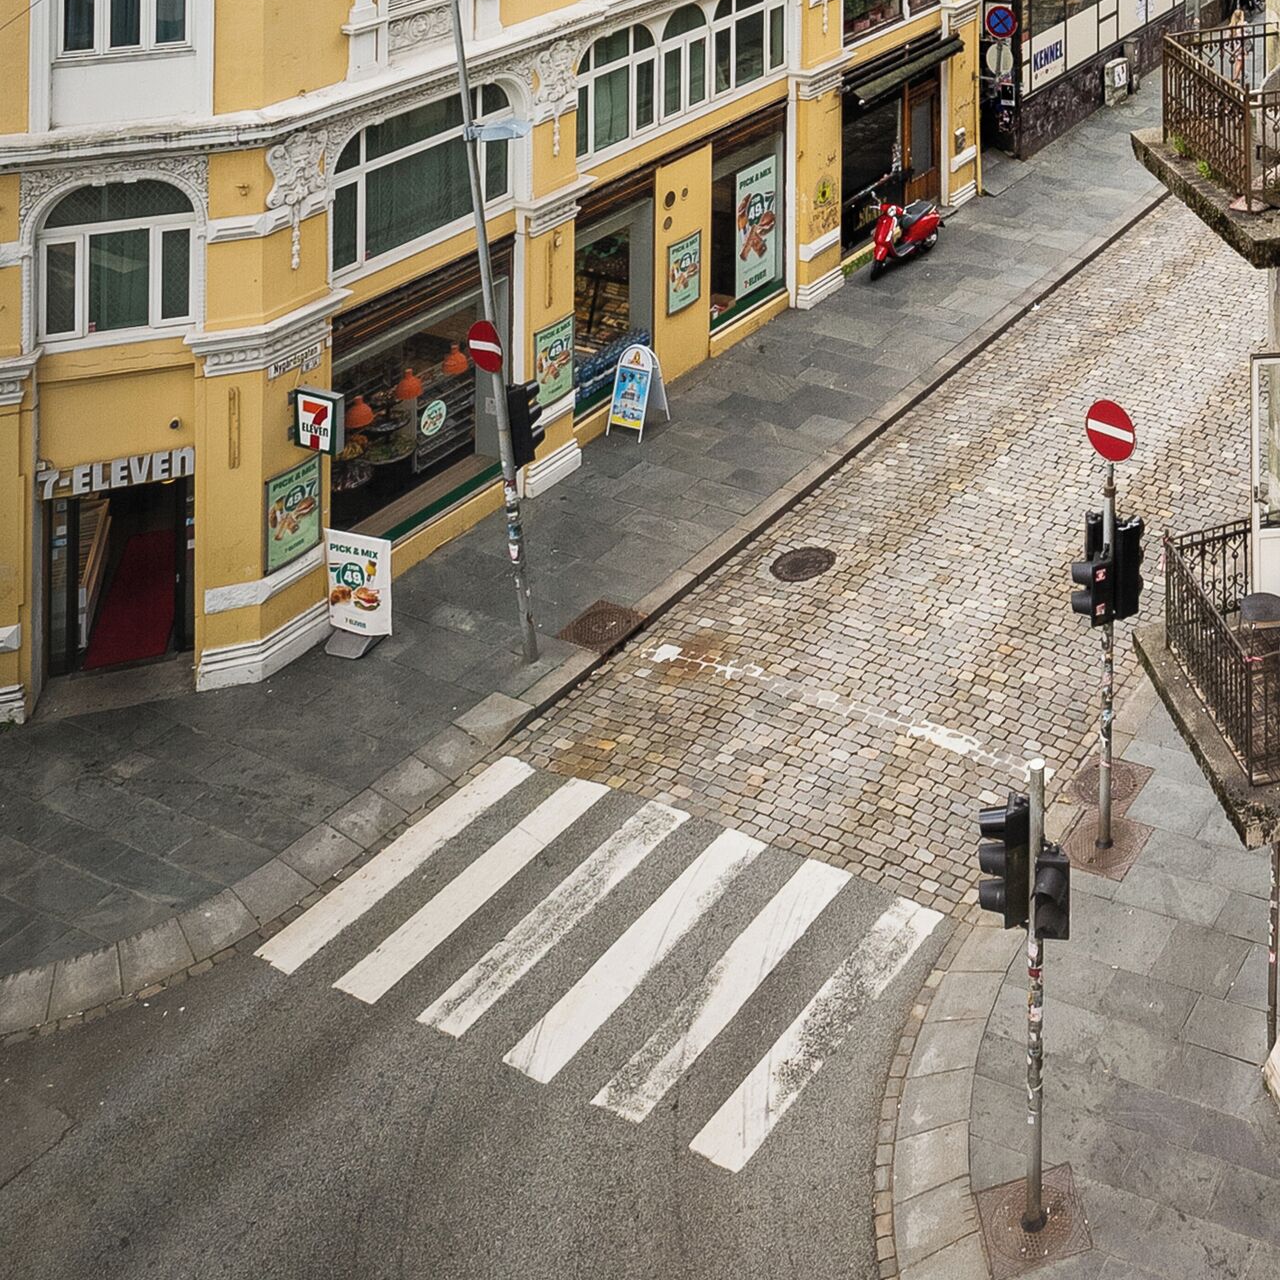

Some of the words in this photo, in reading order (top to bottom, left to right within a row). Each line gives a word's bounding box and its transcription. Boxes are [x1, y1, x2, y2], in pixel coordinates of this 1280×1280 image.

[1033, 39, 1064, 73] KENNEL
[739, 175, 754, 190] PICK
[273, 475, 295, 492] PICK
[329, 542, 352, 555] PICK
[353, 547, 359, 556] &
[361, 549, 378, 560] MIX
